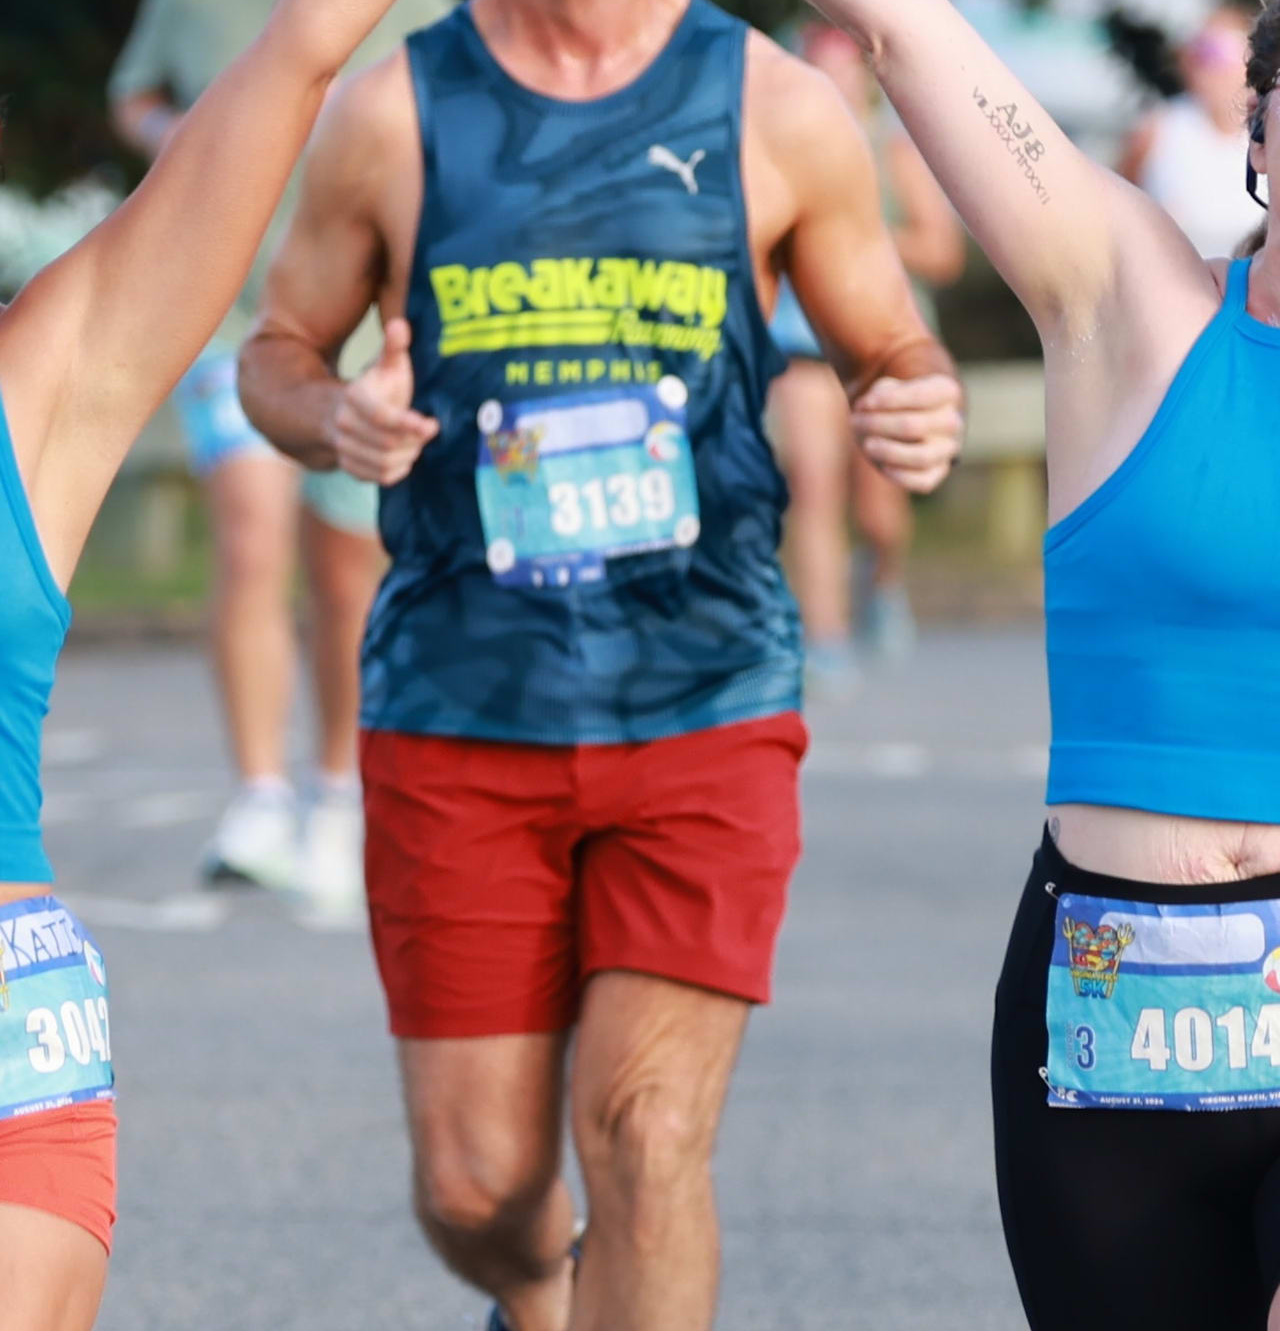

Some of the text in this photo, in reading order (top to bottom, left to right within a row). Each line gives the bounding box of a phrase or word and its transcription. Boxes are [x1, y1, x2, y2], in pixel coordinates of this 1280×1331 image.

[996, 102, 1046, 162] AJB
[430, 256, 727, 329] Breakaway
[505, 358, 662, 385] MEMPHIS
[549, 468, 674, 535] 3139
[1079, 979, 1106, 998] 5K
[1075, 1025, 1095, 1070] 3
[1099, 1096, 1132, 1106] AUGUST
[1199, 1095, 1236, 1105] VIRGINIA
